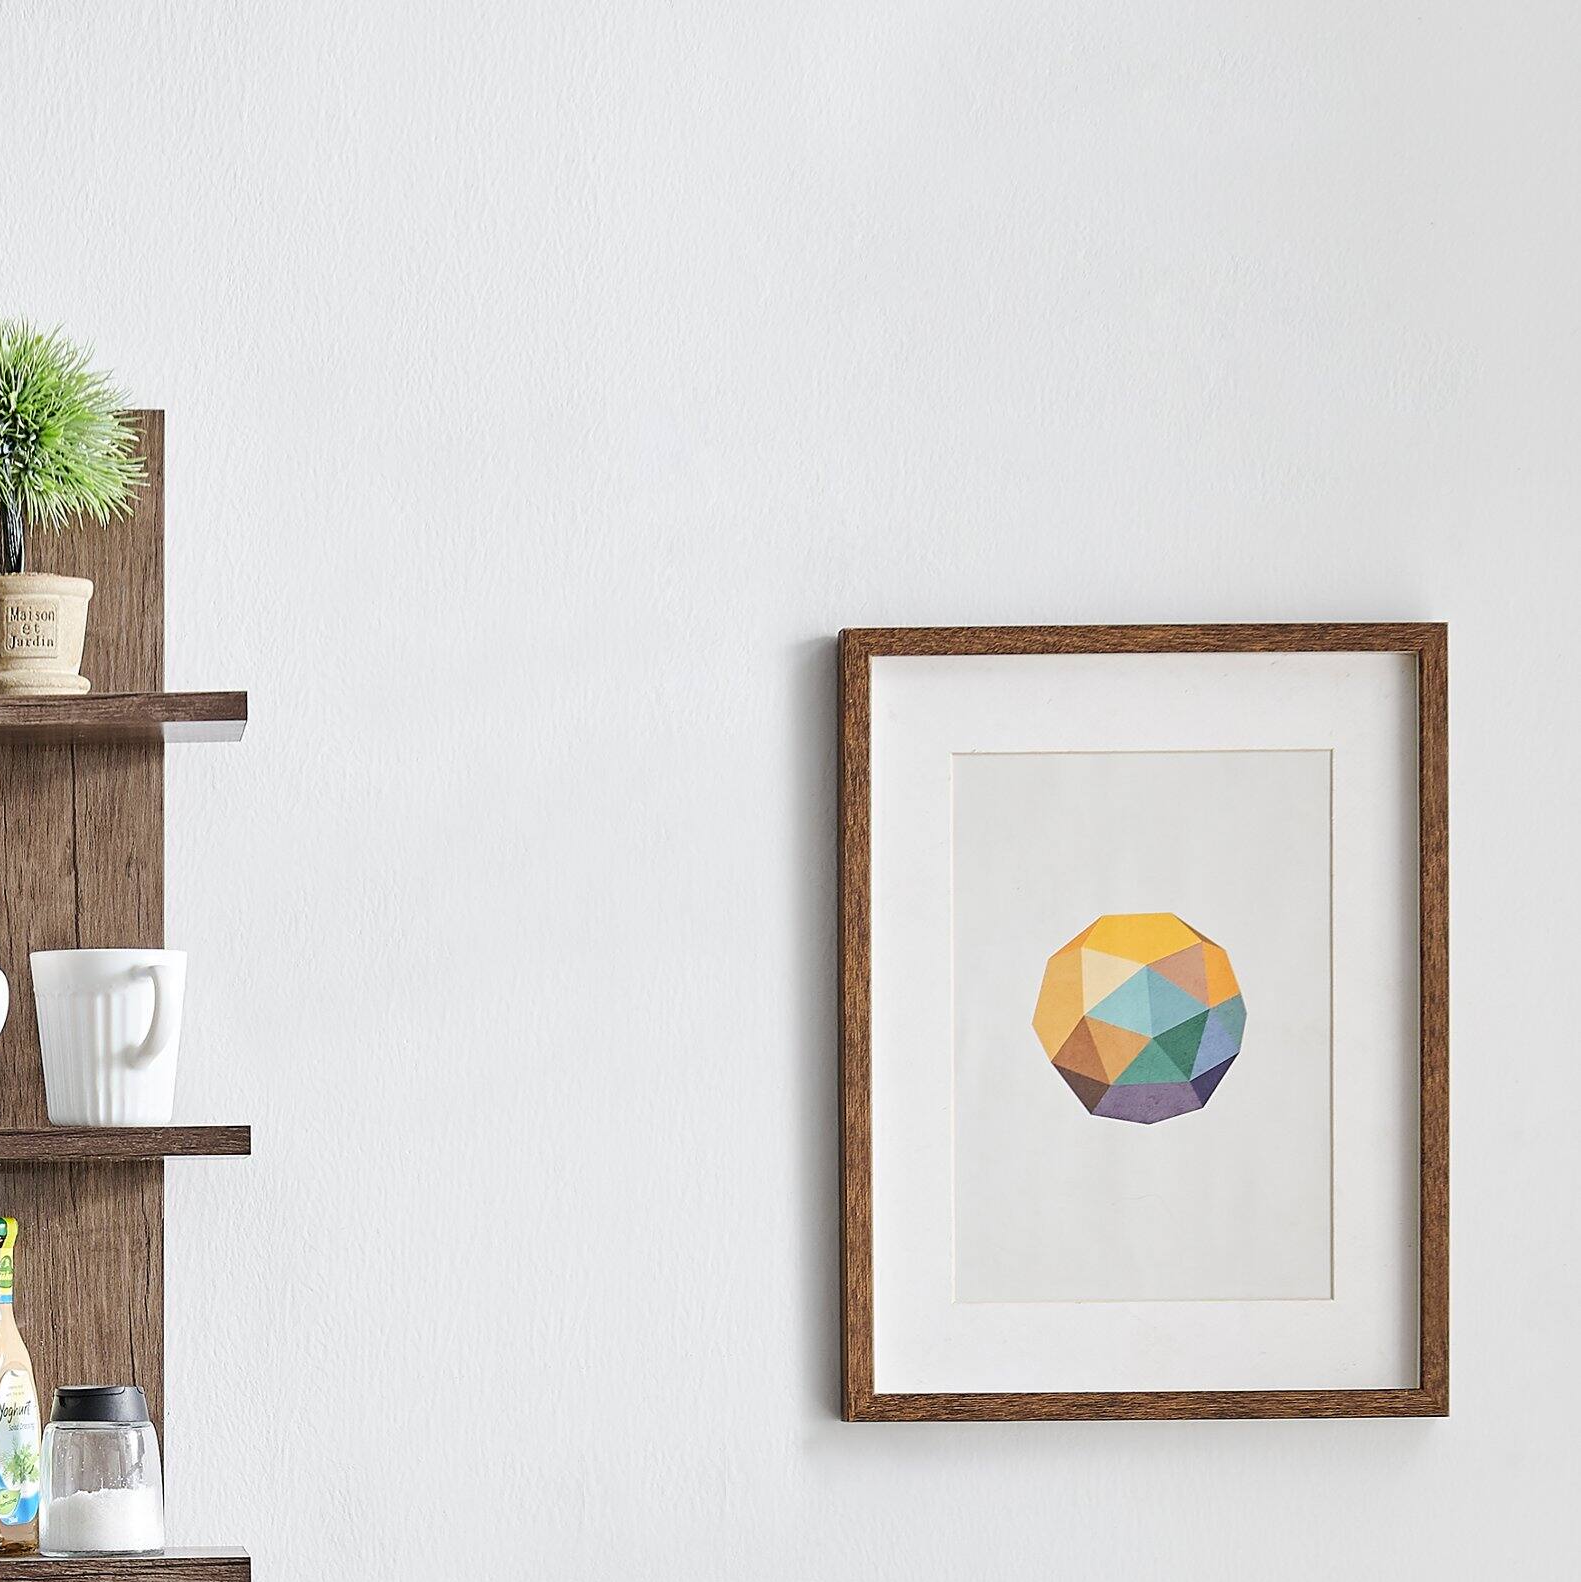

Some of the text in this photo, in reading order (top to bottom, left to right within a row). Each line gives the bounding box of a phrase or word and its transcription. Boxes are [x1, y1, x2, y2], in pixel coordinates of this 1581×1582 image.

[10, 606, 55, 622] Maison
[22, 623, 41, 635] et
[9, 635, 54, 650] Jardin
